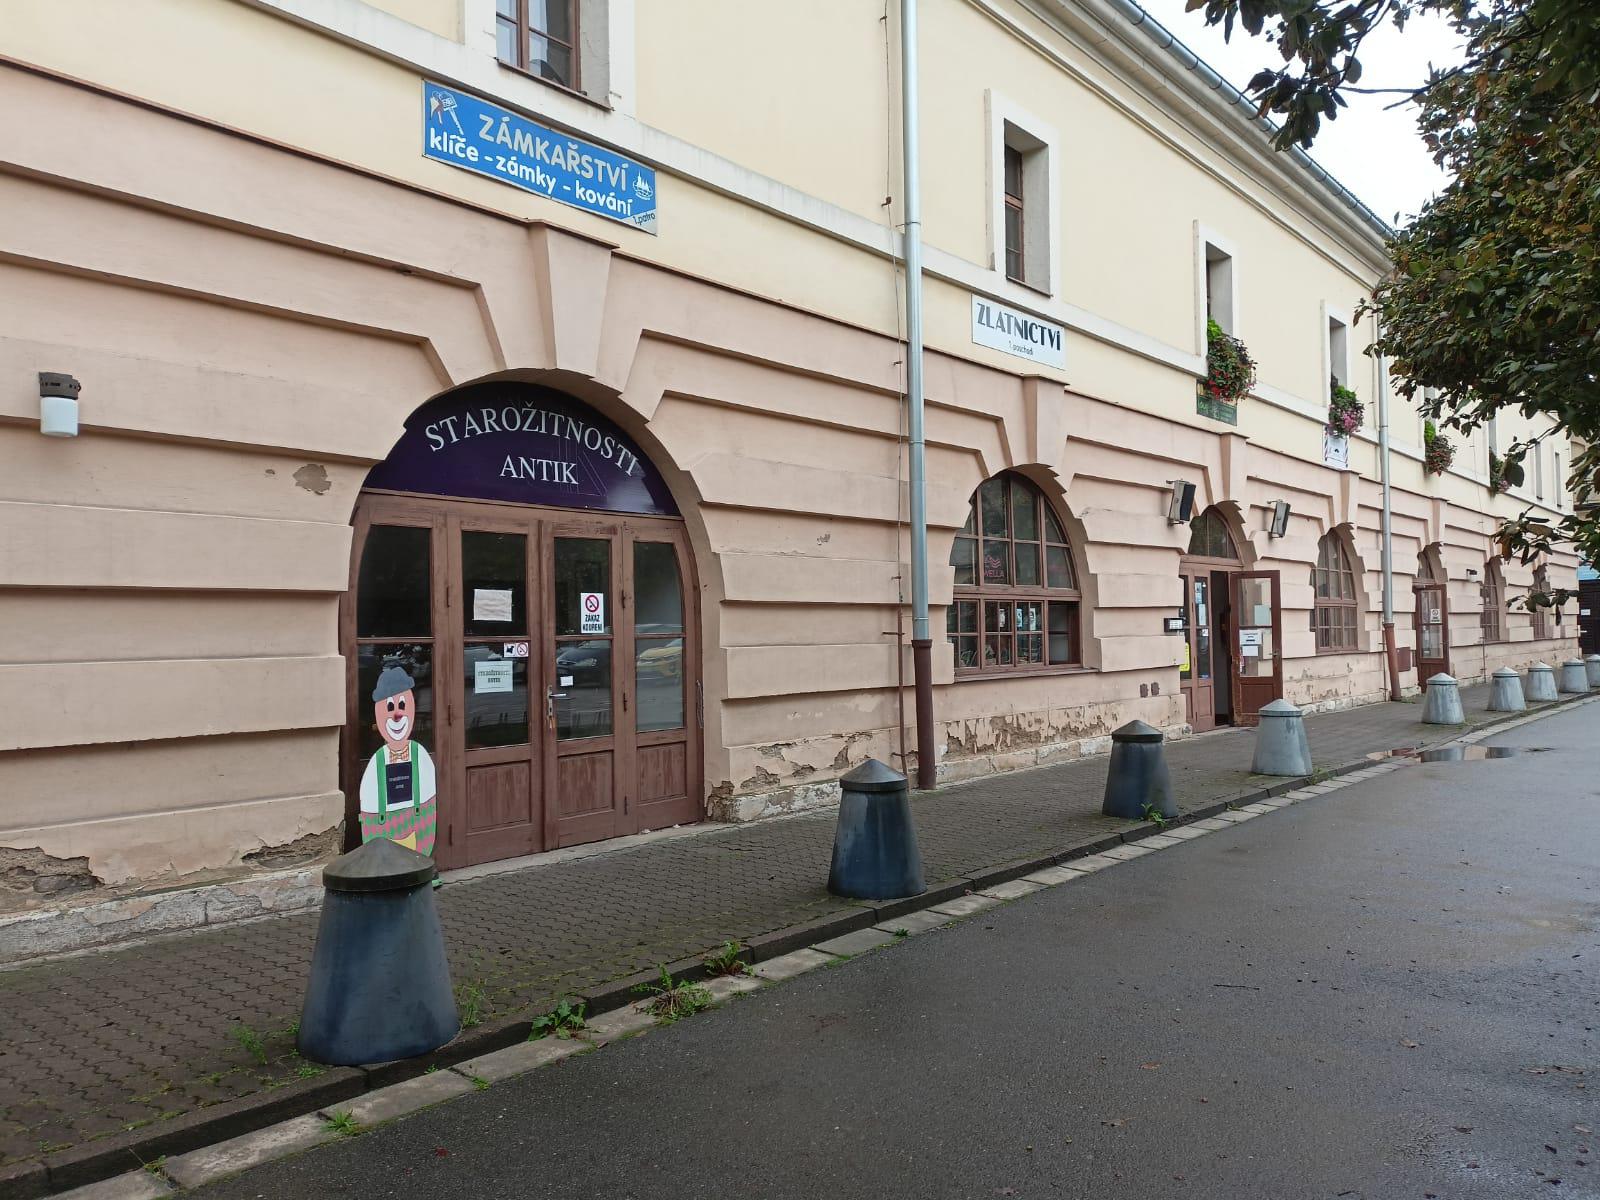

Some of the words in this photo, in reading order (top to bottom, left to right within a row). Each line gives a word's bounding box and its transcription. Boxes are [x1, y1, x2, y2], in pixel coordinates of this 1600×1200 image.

[430, 127, 479, 162] klíče
[495, 155, 557, 194] zámky
[576, 180, 633, 216] kování
[478, 113, 629, 191] ZÁMKAŘSTVÍ
[977, 302, 1061, 351] ZLATNICTVÍ
[425, 400, 640, 477] STAROŽITNOSTI
[500, 455, 579, 485] ANTIK
